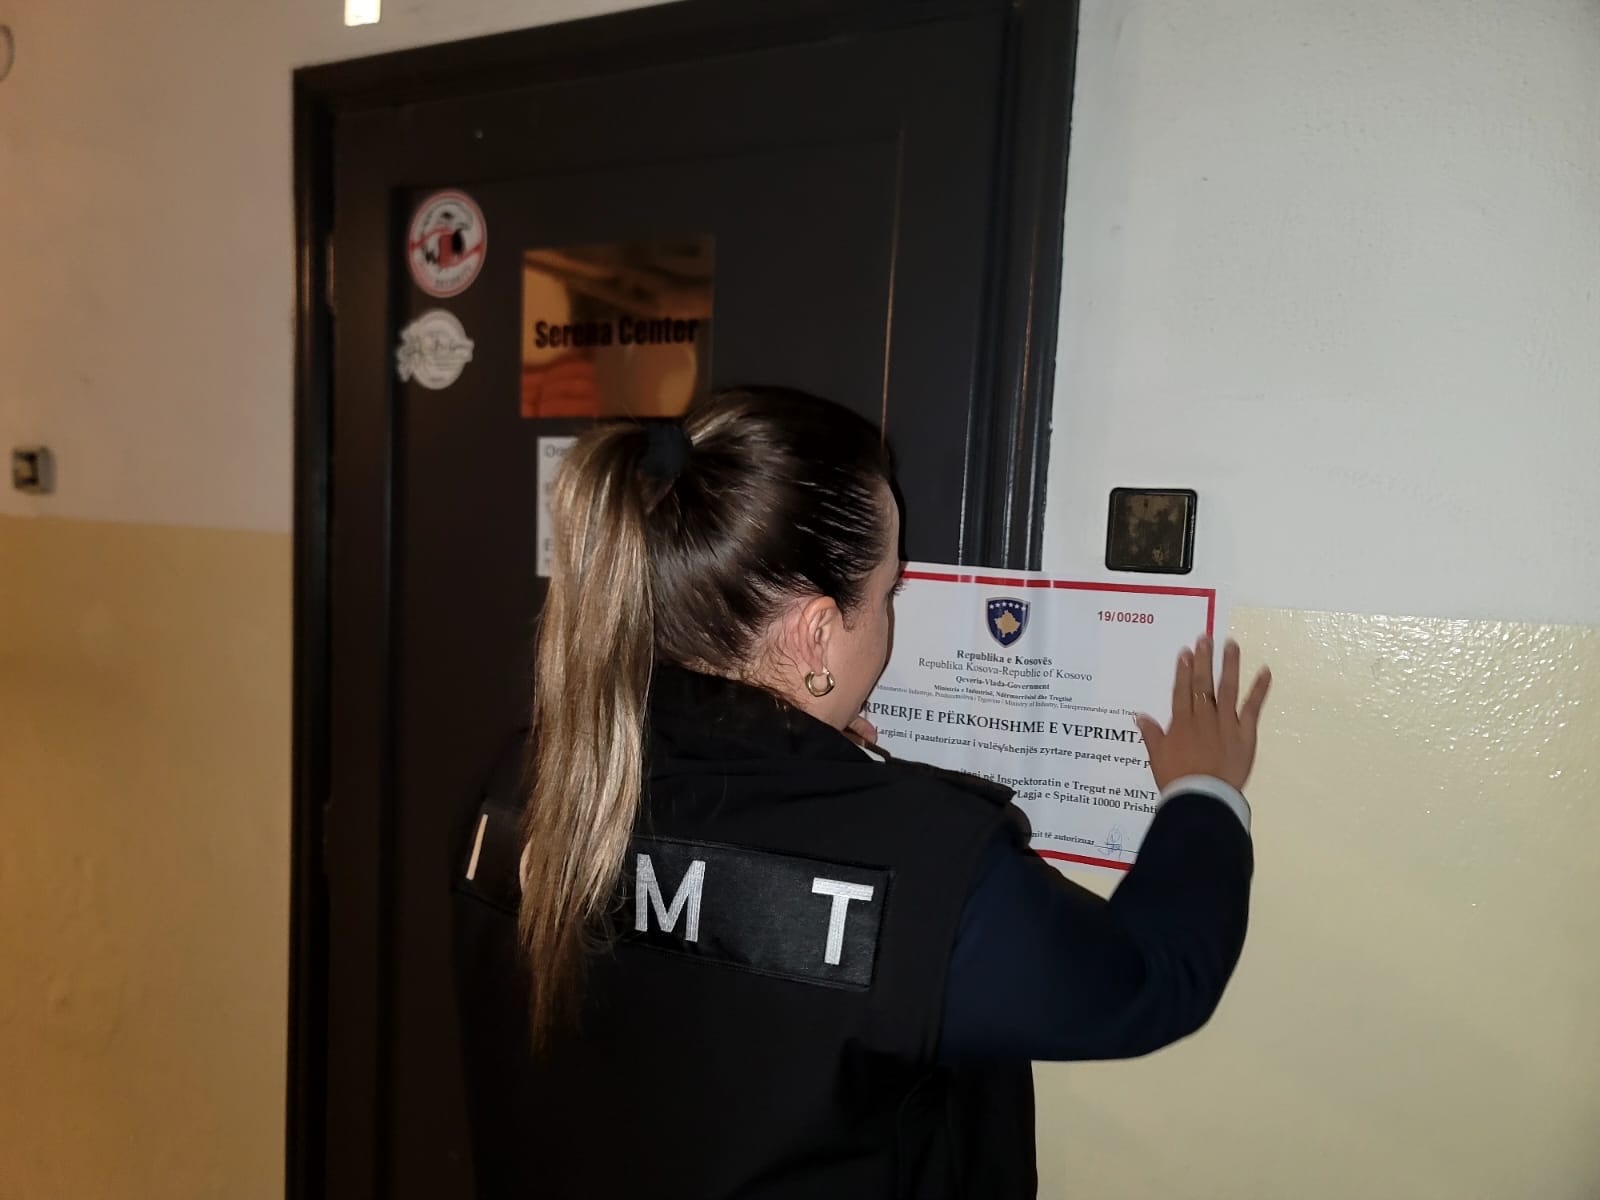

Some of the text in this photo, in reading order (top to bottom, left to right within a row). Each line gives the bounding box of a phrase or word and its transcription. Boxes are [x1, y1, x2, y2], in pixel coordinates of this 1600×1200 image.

[534, 316, 697, 348] Serena Center
[1097, 610, 1154, 624] 19/00280
[918, 657, 1093, 682] Republika Kosova-Republic of Kosovo
[957, 650, 1005, 664] Republika
[1015, 656, 1053, 666] Kosovës
[926, 709, 935, 721] E
[938, 711, 1044, 733] PËRKOHSHME
[1049, 721, 1058, 733] E
[1062, 723, 1144, 743] VEPRIMT
[914, 733, 970, 747] paautorizuar
[1040, 747, 1072, 756] zyrtare
[1075, 750, 1111, 763] paraqet
[1114, 756, 1142, 766] vepër
[997, 774, 1061, 789] Inspektoratin
[1072, 781, 1106, 795] Tregut
[1109, 788, 1121, 796] në
[1124, 789, 1157, 801] MINT
[1017, 790, 1043, 801] Lagja
[1053, 791, 1089, 803] Spitalit
[1093, 797, 1121, 808] 10000
[1054, 834, 1095, 846] autorizuar
